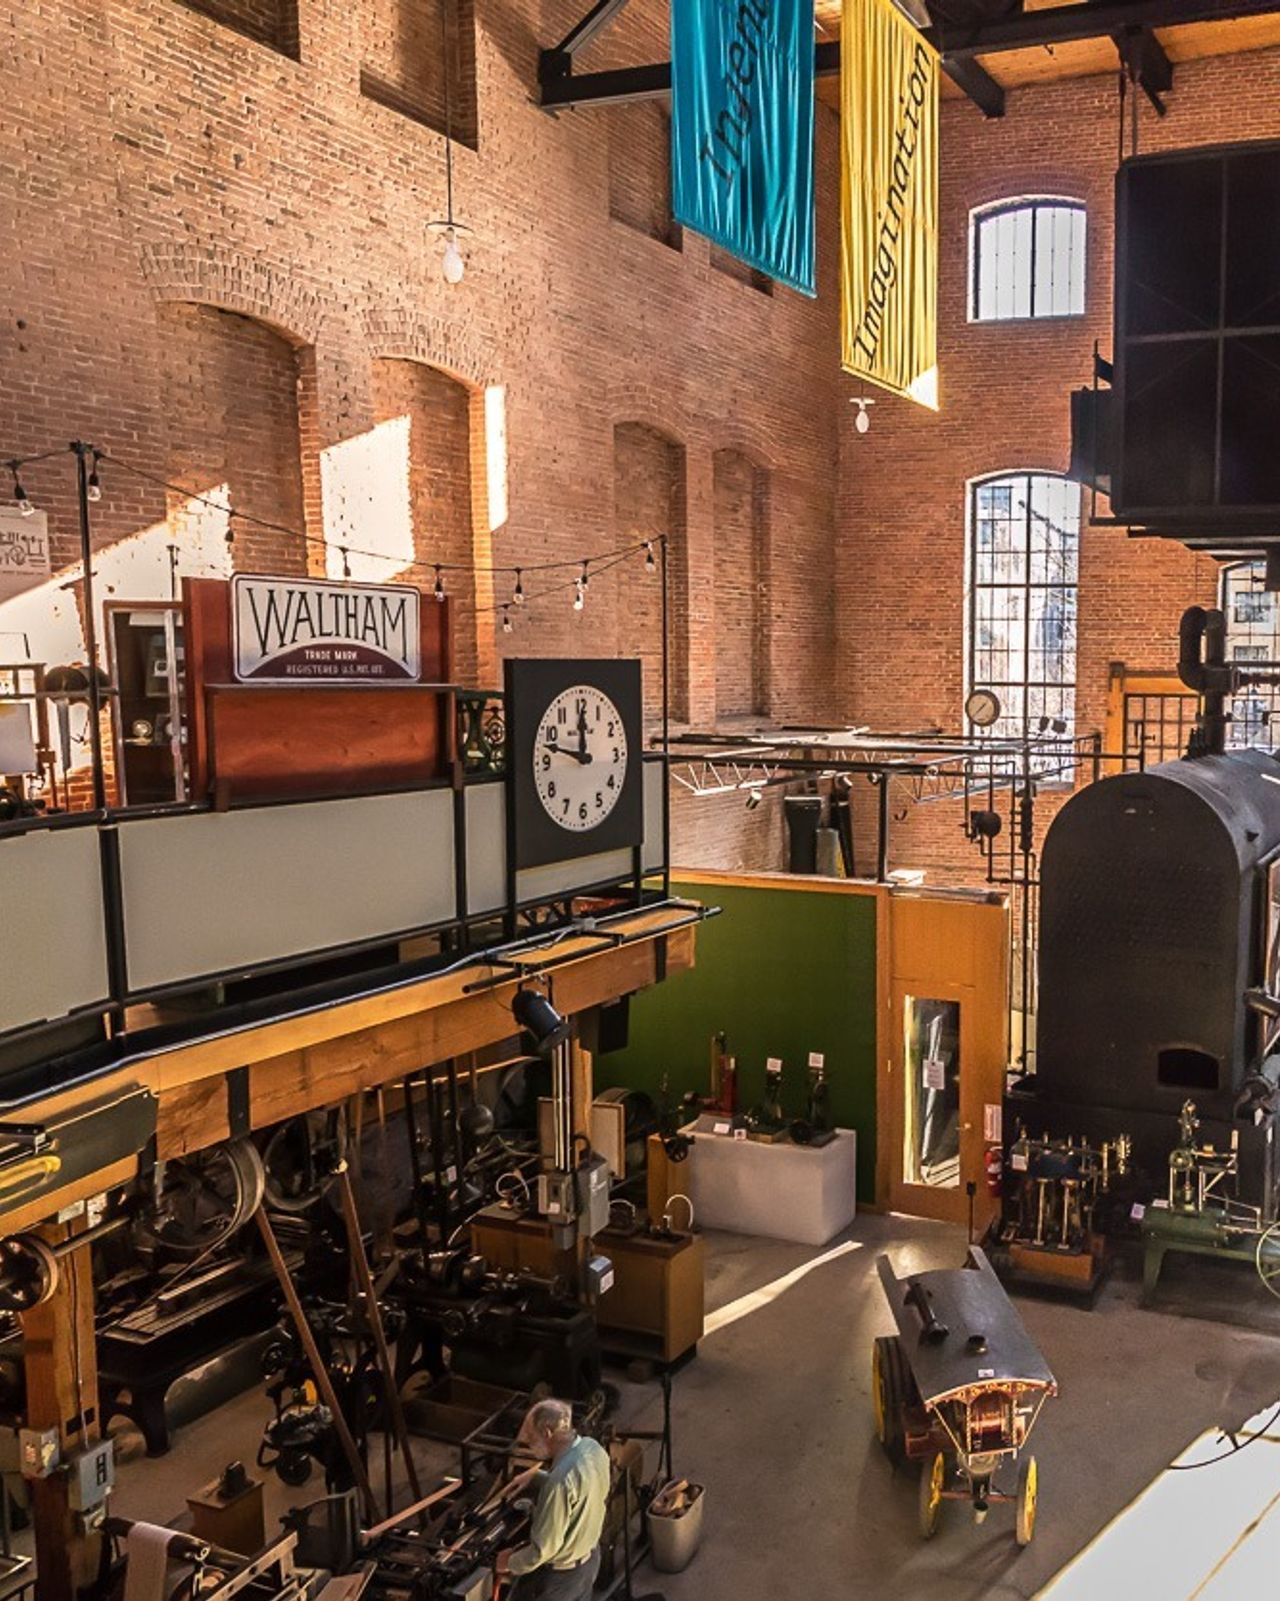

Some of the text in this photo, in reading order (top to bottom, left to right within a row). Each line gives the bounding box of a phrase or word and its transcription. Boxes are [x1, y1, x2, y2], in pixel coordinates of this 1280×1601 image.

[852, 43, 930, 371] Imagination
[246, 588, 407, 665] WALTHAM
[305, 650, 358, 661] TRADE MARK
[286, 664, 339, 674] REGISTERED
[558, 707, 566, 724] 11
[596, 705, 600, 721] 1
[546, 725, 558, 742] 10
[607, 721, 615, 737] 2
[542, 754, 551, 771] 9
[612, 747, 620, 763] 3
[547, 781, 556, 798] 8
[607, 774, 615, 790] 4
[562, 798, 570, 815] 7
[595, 792, 603, 808] 5
[578, 802, 587, 820] 6
